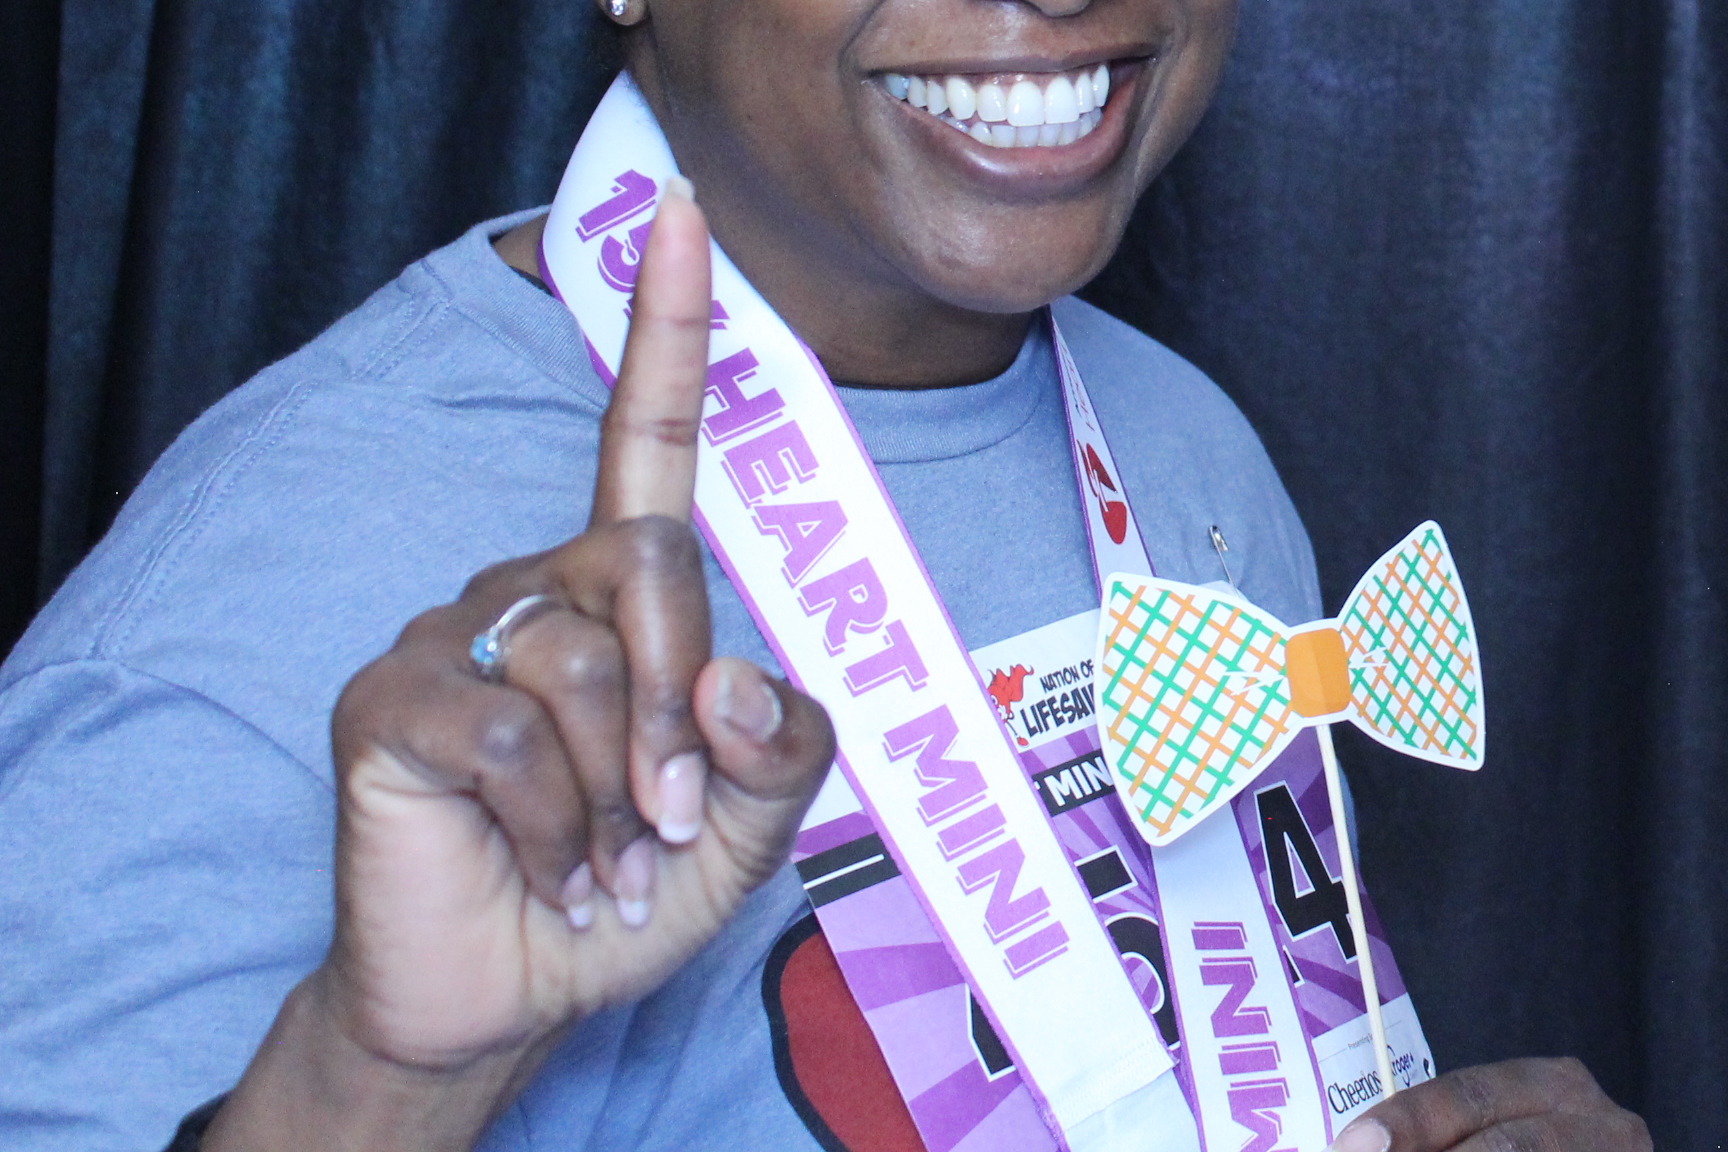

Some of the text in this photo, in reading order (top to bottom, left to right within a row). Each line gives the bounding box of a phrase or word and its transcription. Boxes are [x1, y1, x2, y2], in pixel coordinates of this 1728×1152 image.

[700, 347, 929, 697] HEART
[883, 703, 1070, 980] MINI
[1039, 658, 1095, 694] NATION OF
[1327, 1069, 1384, 1114] Cheerios
